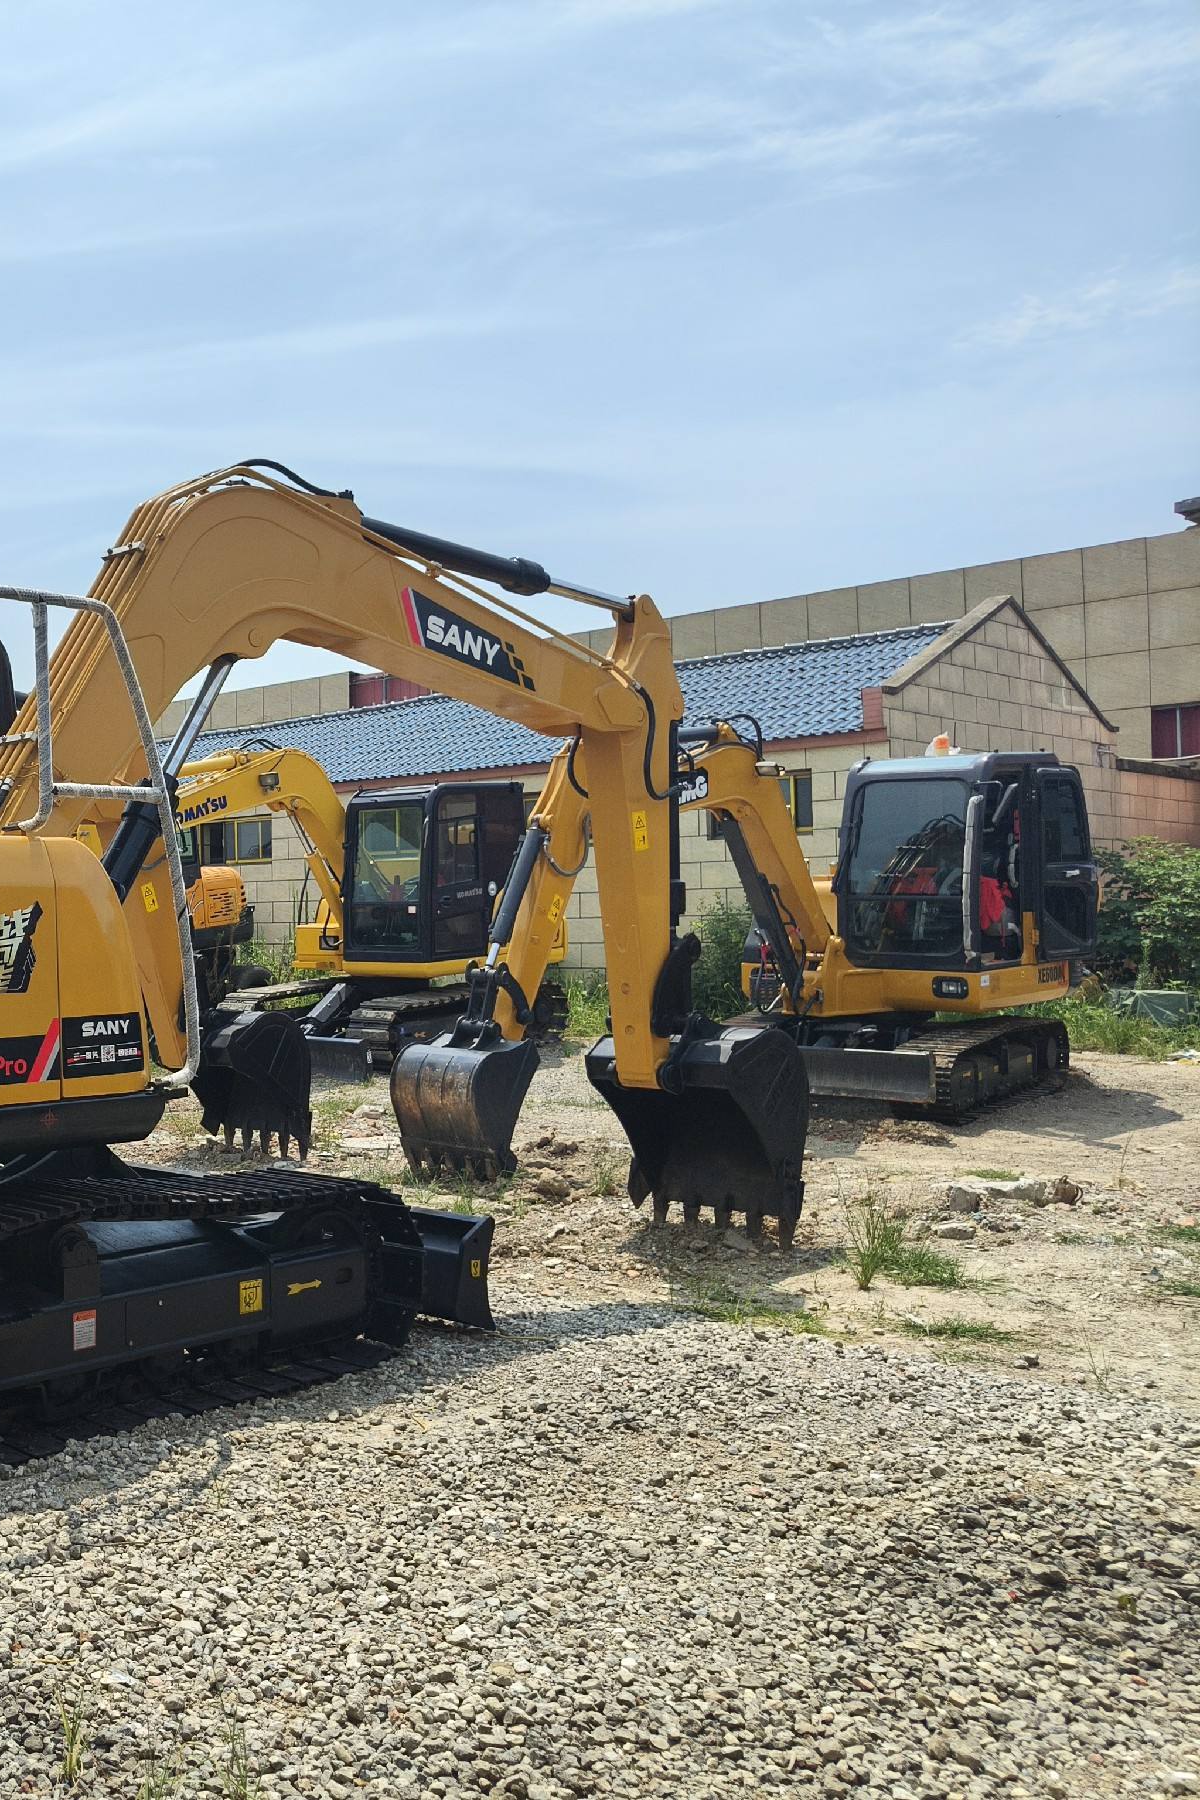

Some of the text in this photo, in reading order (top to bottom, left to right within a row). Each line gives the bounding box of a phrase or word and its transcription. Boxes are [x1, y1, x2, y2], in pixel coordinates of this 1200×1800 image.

[426, 614, 500, 666] SANY
[679, 775, 707, 804] MG
[175, 795, 228, 824] OMATSU
[82, 1020, 130, 1037] SANY
